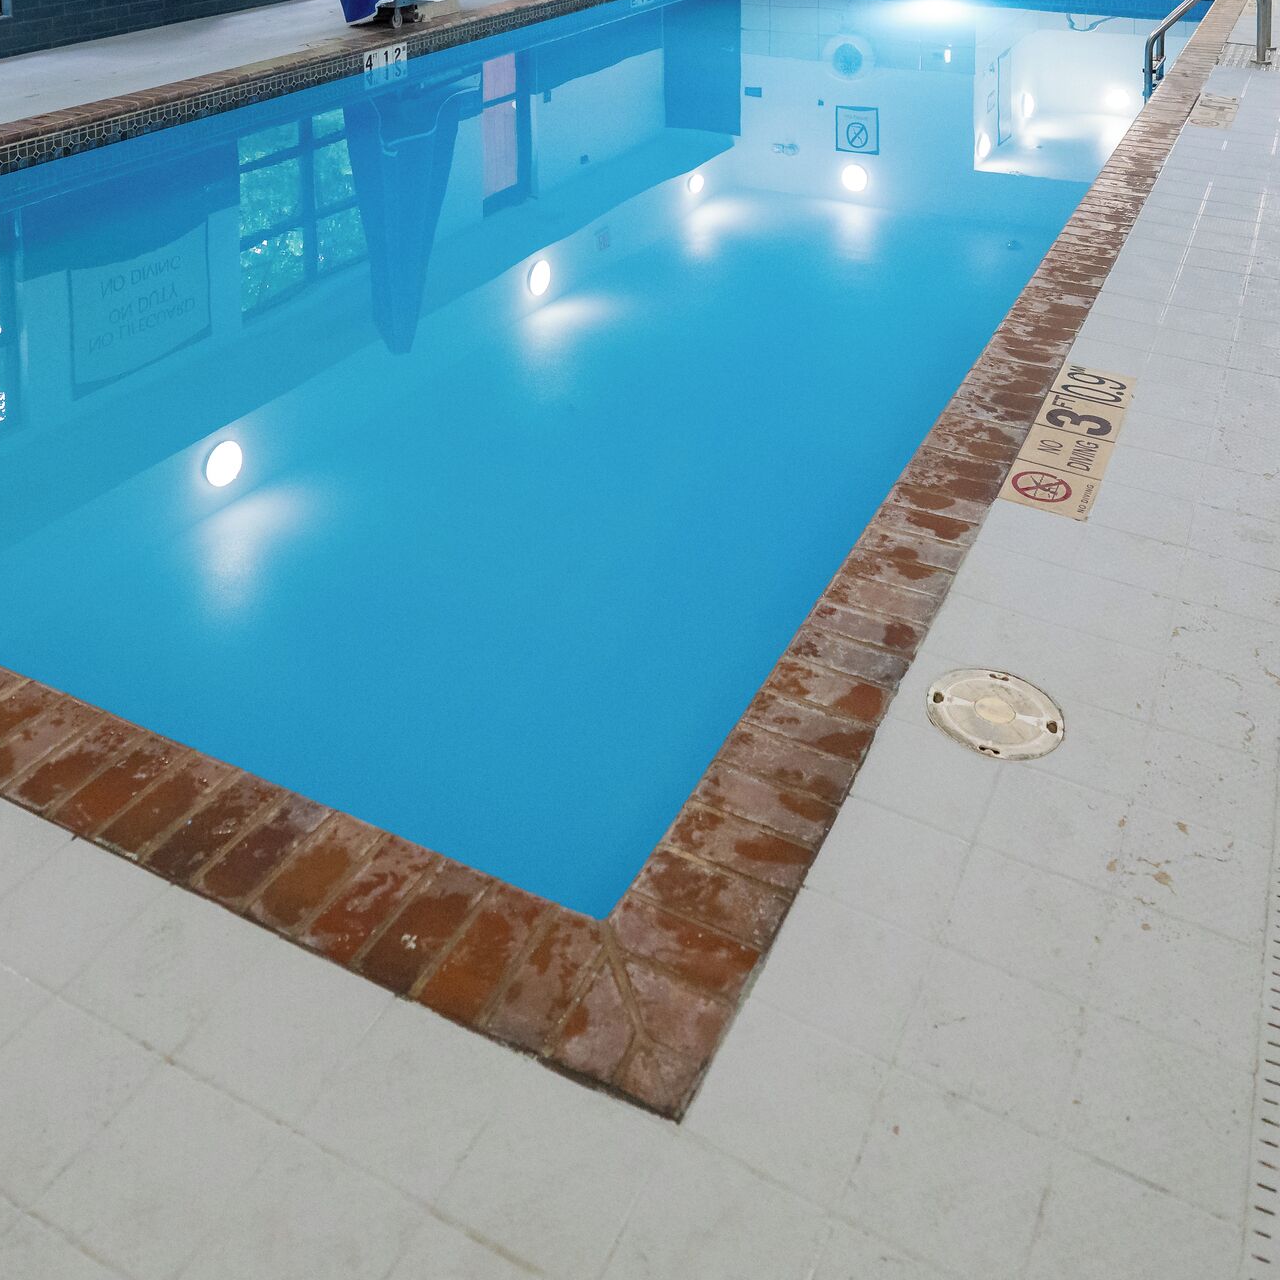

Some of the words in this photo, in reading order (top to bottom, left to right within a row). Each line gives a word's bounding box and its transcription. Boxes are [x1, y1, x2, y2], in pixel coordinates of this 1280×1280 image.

[365, 54, 373, 70] 4
[394, 47, 401, 62] 2
[1069, 365, 1087, 376] M
[1061, 372, 1127, 403] 0.9
[1051, 394, 1076, 410] FT
[1045, 408, 1112, 436] 3
[1037, 439, 1063, 456] NO
[1066, 439, 1100, 472] DIVING
[1081, 483, 1095, 504] DIVING
[1077, 504, 1086, 514] NO
